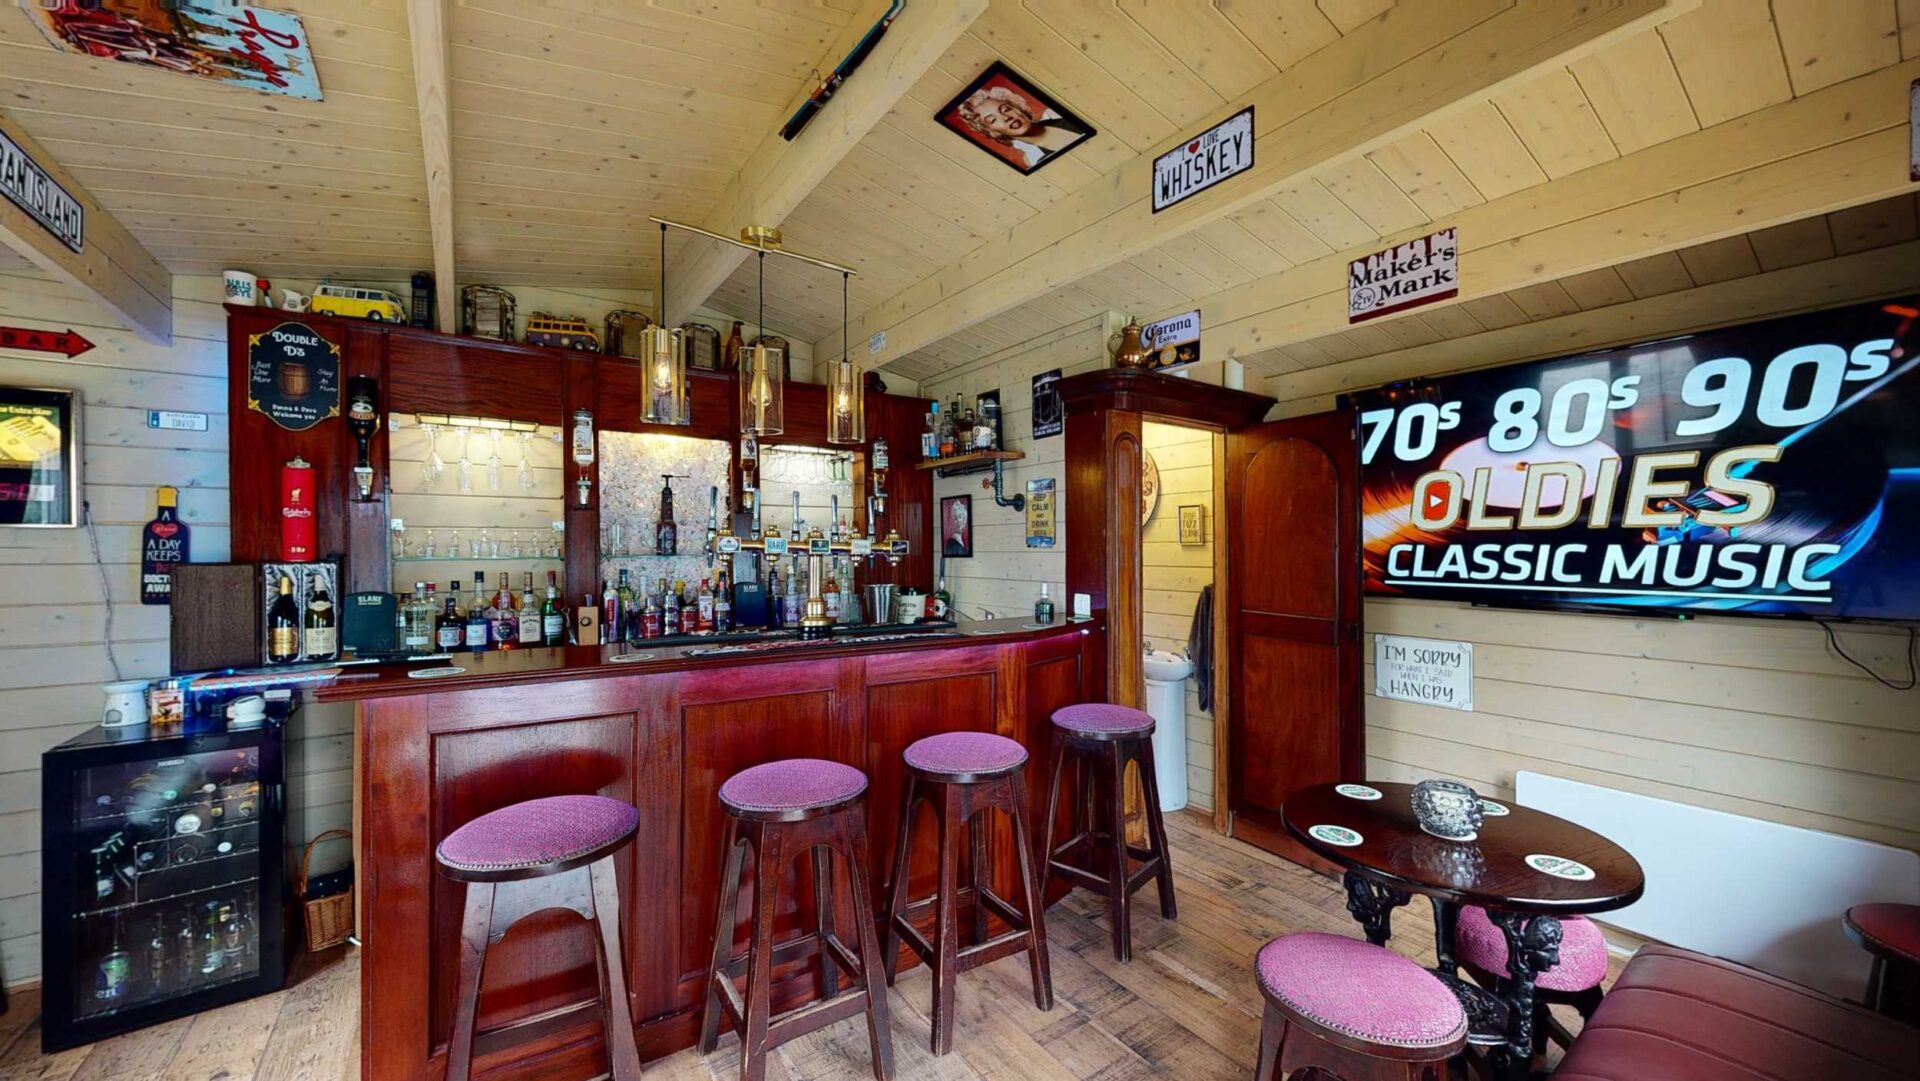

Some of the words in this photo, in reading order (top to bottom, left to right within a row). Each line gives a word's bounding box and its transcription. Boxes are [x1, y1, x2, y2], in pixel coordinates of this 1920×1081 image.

[1180, 148, 1185, 160] I
[1203, 129, 1220, 148] LOVE
[1161, 131, 1243, 202] WHISKEY
[30, 170, 79, 240] ISLAND
[1376, 268, 1453, 306] Mark
[2, 331, 69, 349] BAR
[272, 331, 319, 346] DOUBLE
[1144, 318, 1192, 341] Corona
[1675, 338, 1895, 437] 90s
[272, 411, 302, 419] Welcome
[1487, 375, 1641, 454] 80s
[1361, 401, 1462, 465] 70s
[1410, 444, 1786, 532] OLDIES
[162, 510, 170, 520] A
[1032, 502, 1049, 511] CALM
[1031, 520, 1049, 528] DRINK
[147, 539, 156, 550] A
[160, 539, 181, 551] DAY
[147, 550, 181, 561] KEEPS
[144, 574, 171, 584] DOCT
[1387, 543, 1588, 582] CLASSIC
[1599, 543, 1841, 592] MUSIC
[146, 583, 171, 593] AWA
[1384, 645, 1406, 662] I'M
[1413, 648, 1461, 668] SORRY
[1390, 679, 1453, 702] HANGRY
